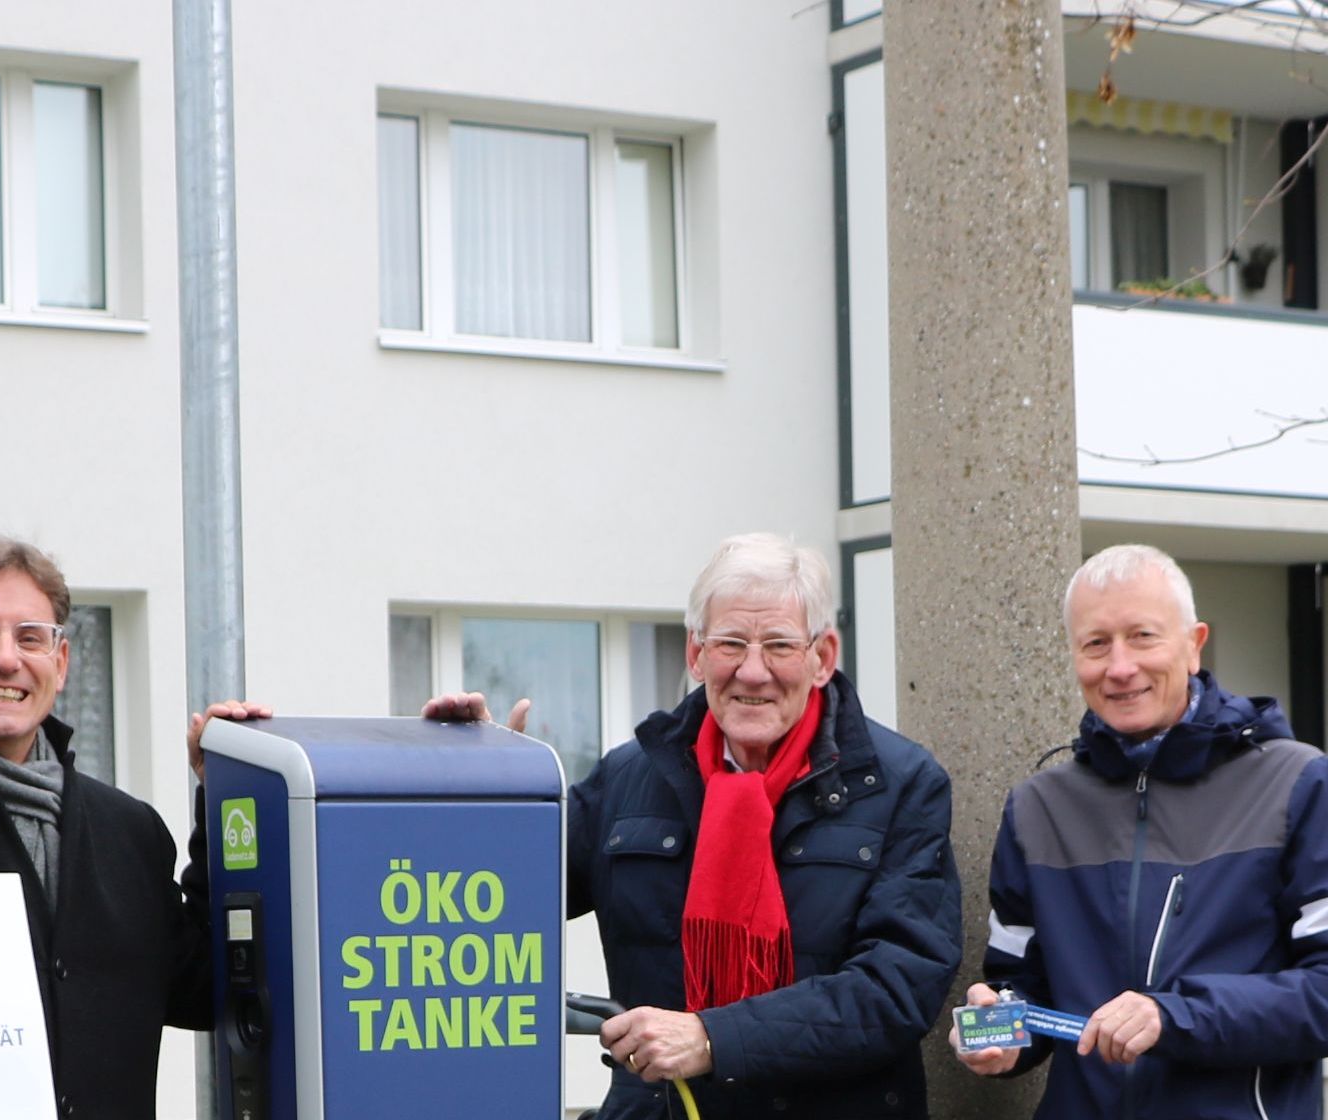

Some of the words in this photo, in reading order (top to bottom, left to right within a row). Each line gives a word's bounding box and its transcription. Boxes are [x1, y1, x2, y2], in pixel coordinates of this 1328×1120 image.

[380, 858, 504, 924] ÖKO
[341, 932, 543, 989] STROM
[347, 994, 537, 1051] TANKE
[965, 1033, 1013, 1045] TANK-CARD
